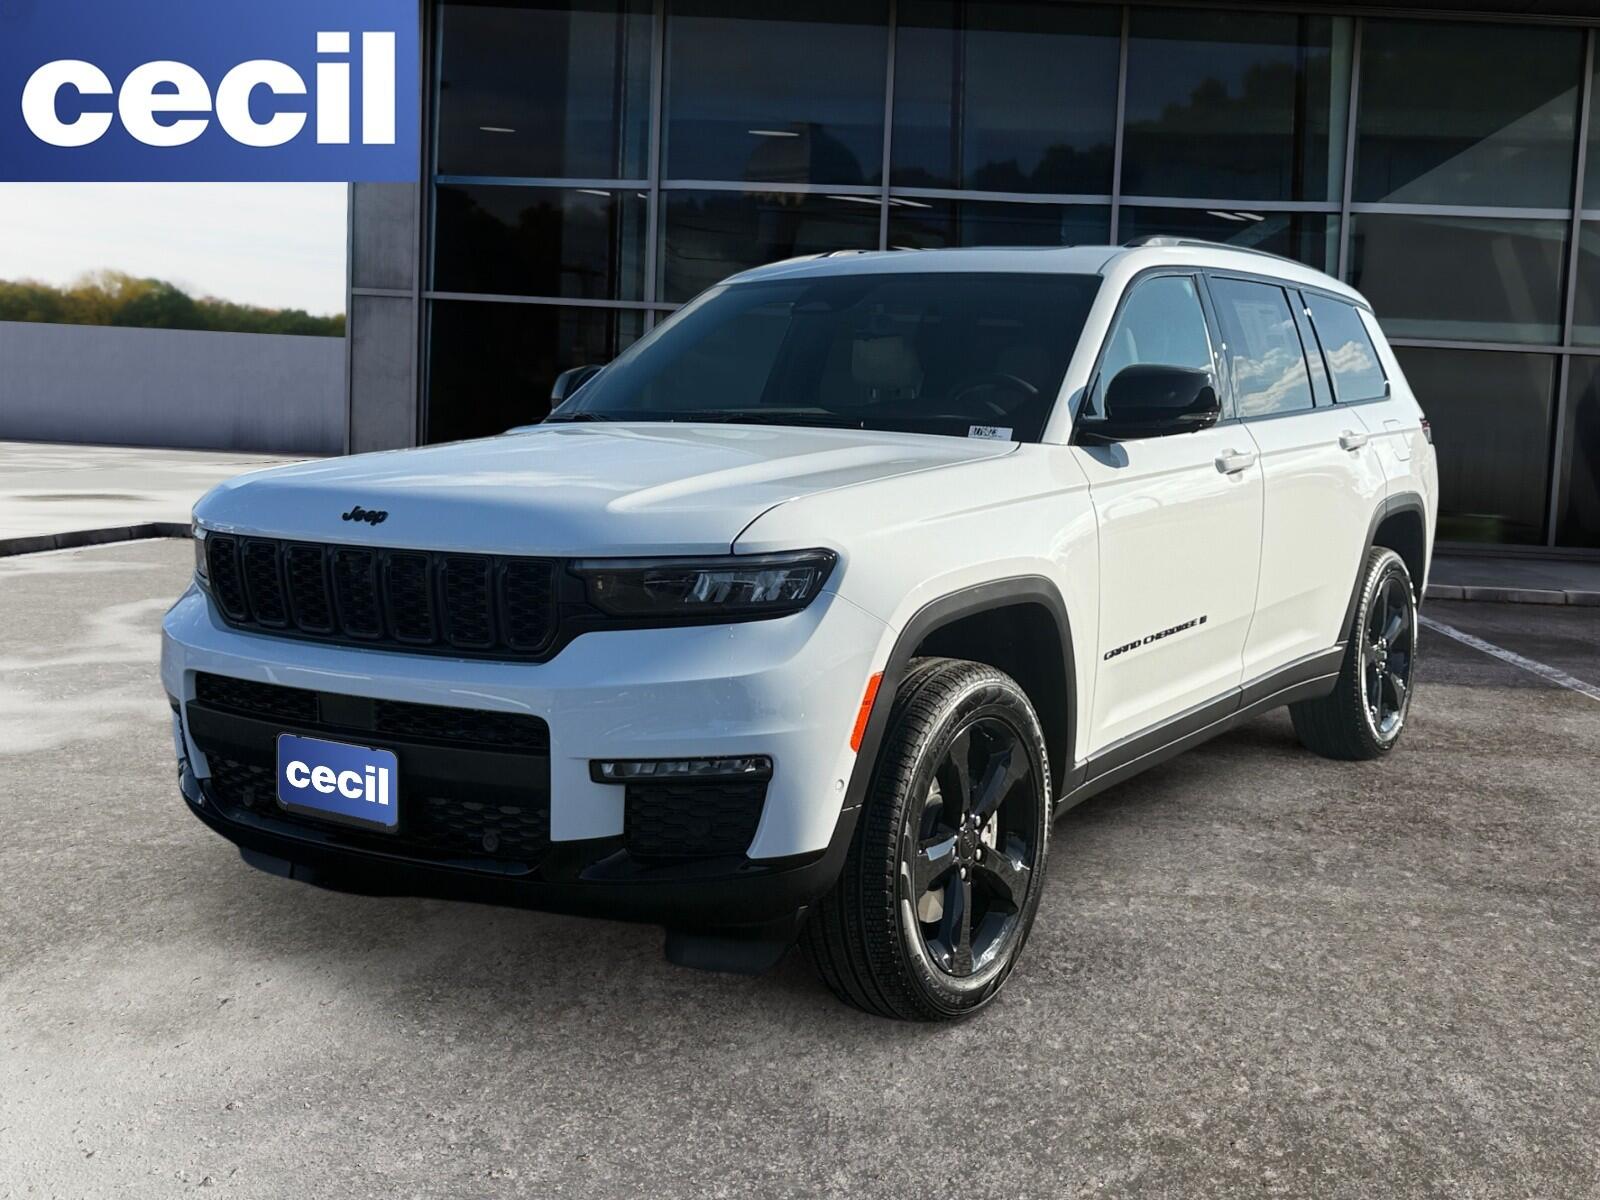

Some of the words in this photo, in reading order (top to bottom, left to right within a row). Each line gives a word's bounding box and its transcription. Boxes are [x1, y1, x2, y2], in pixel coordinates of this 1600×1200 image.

[342, 505, 389, 526] Jeep
[1103, 639, 1142, 661] GRAND
[1143, 618, 1198, 645] CHEROKEE
